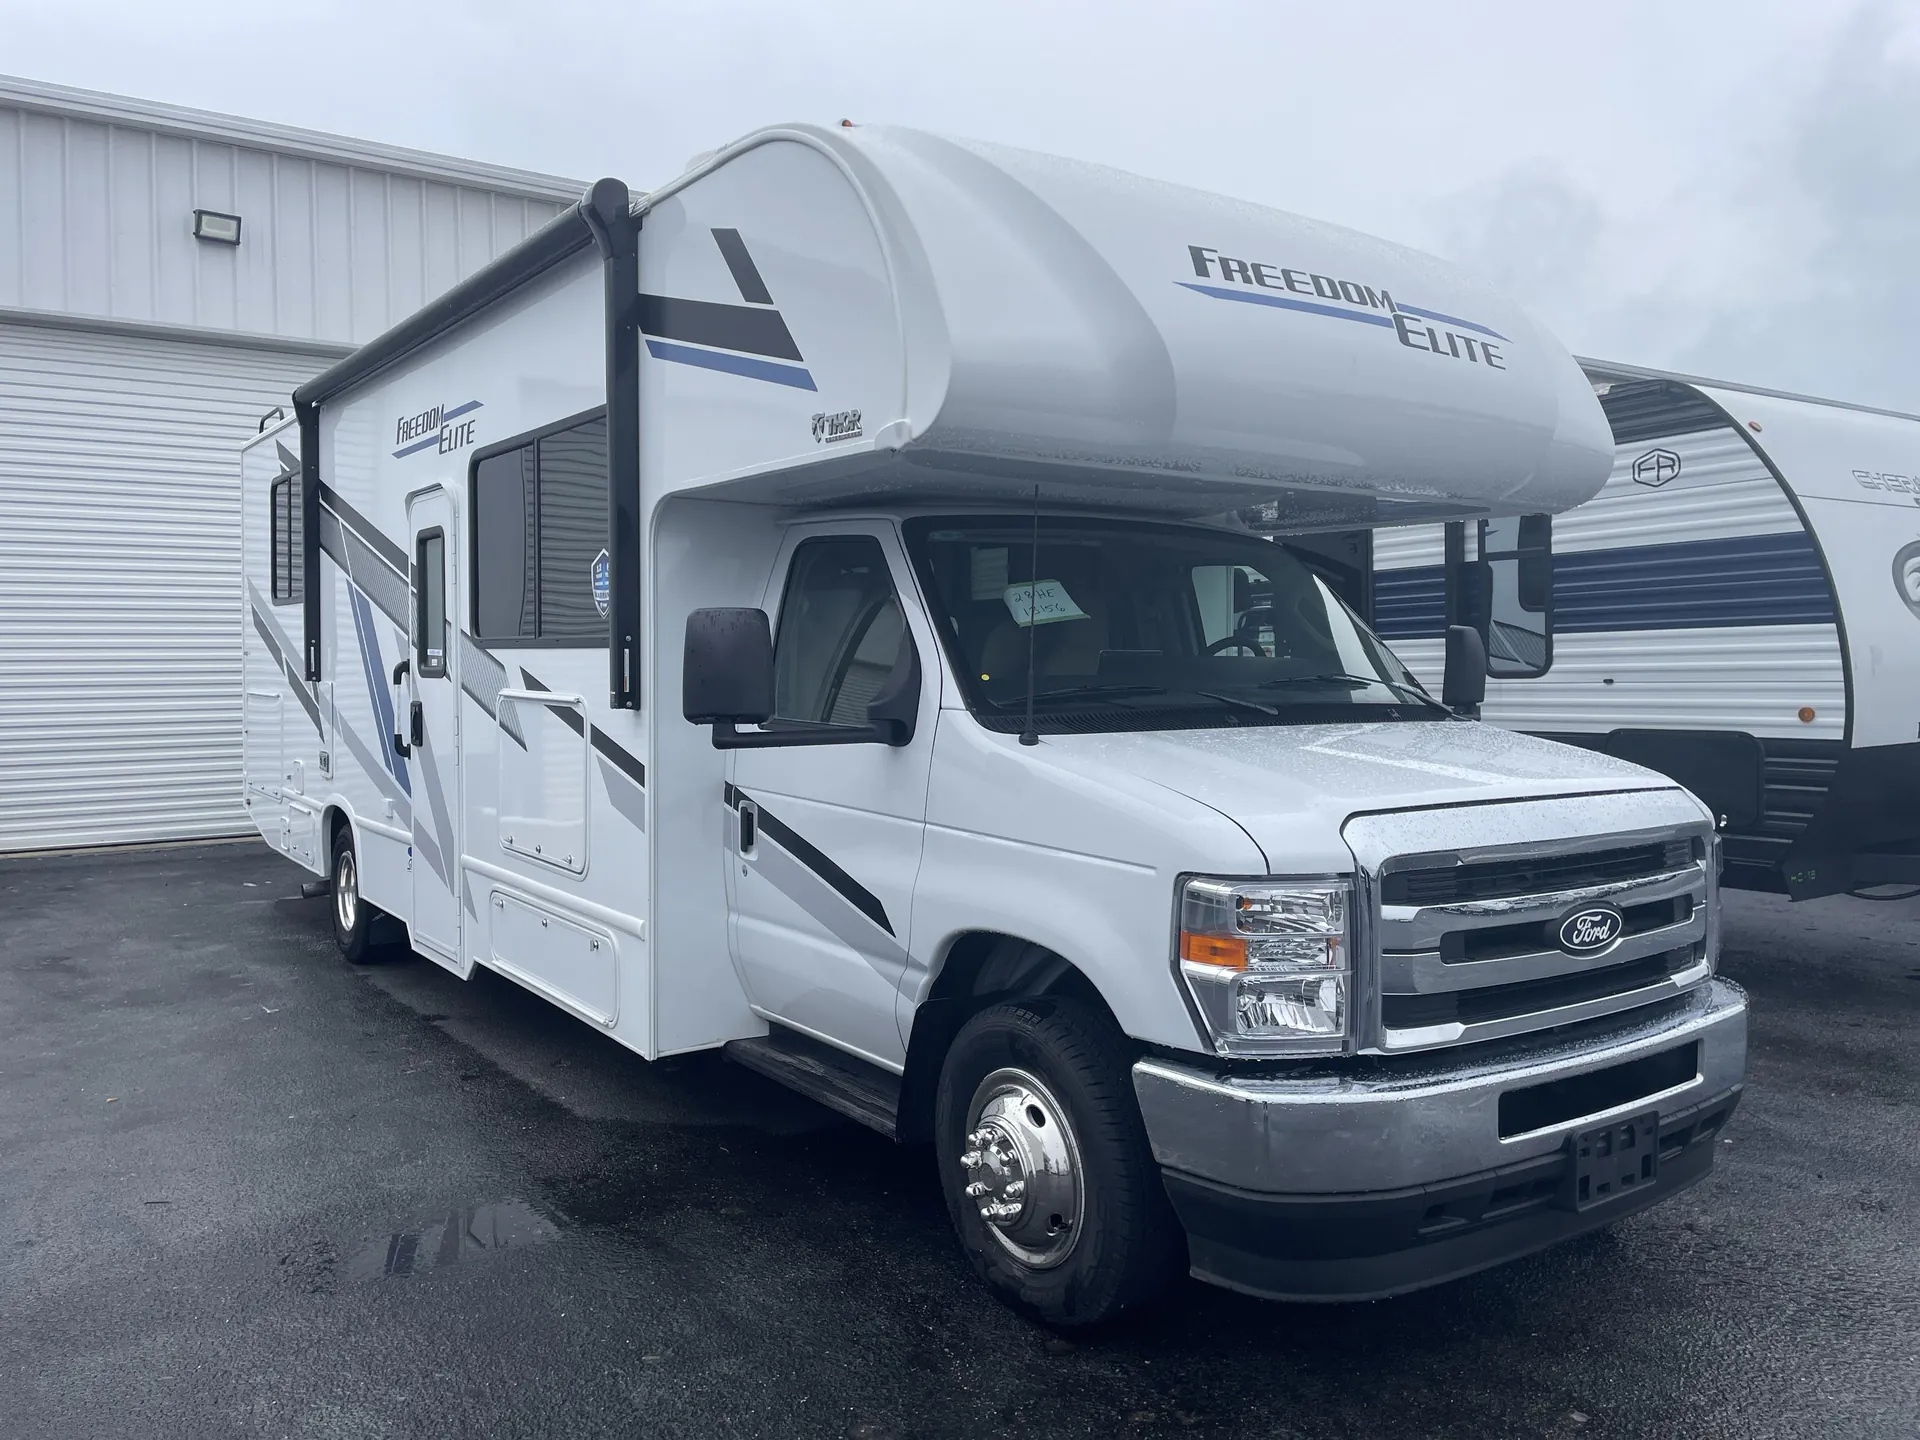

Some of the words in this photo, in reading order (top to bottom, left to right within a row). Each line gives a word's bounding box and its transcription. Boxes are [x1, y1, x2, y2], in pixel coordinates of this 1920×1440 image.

[1188, 244, 1397, 314] FREEDOM
[1392, 313, 1506, 371] ELITE
[396, 404, 444, 445] FREEDOM
[438, 419, 476, 455] ELITE
[825, 409, 862, 436] THOR
[1572, 914, 1611, 944] Ford
